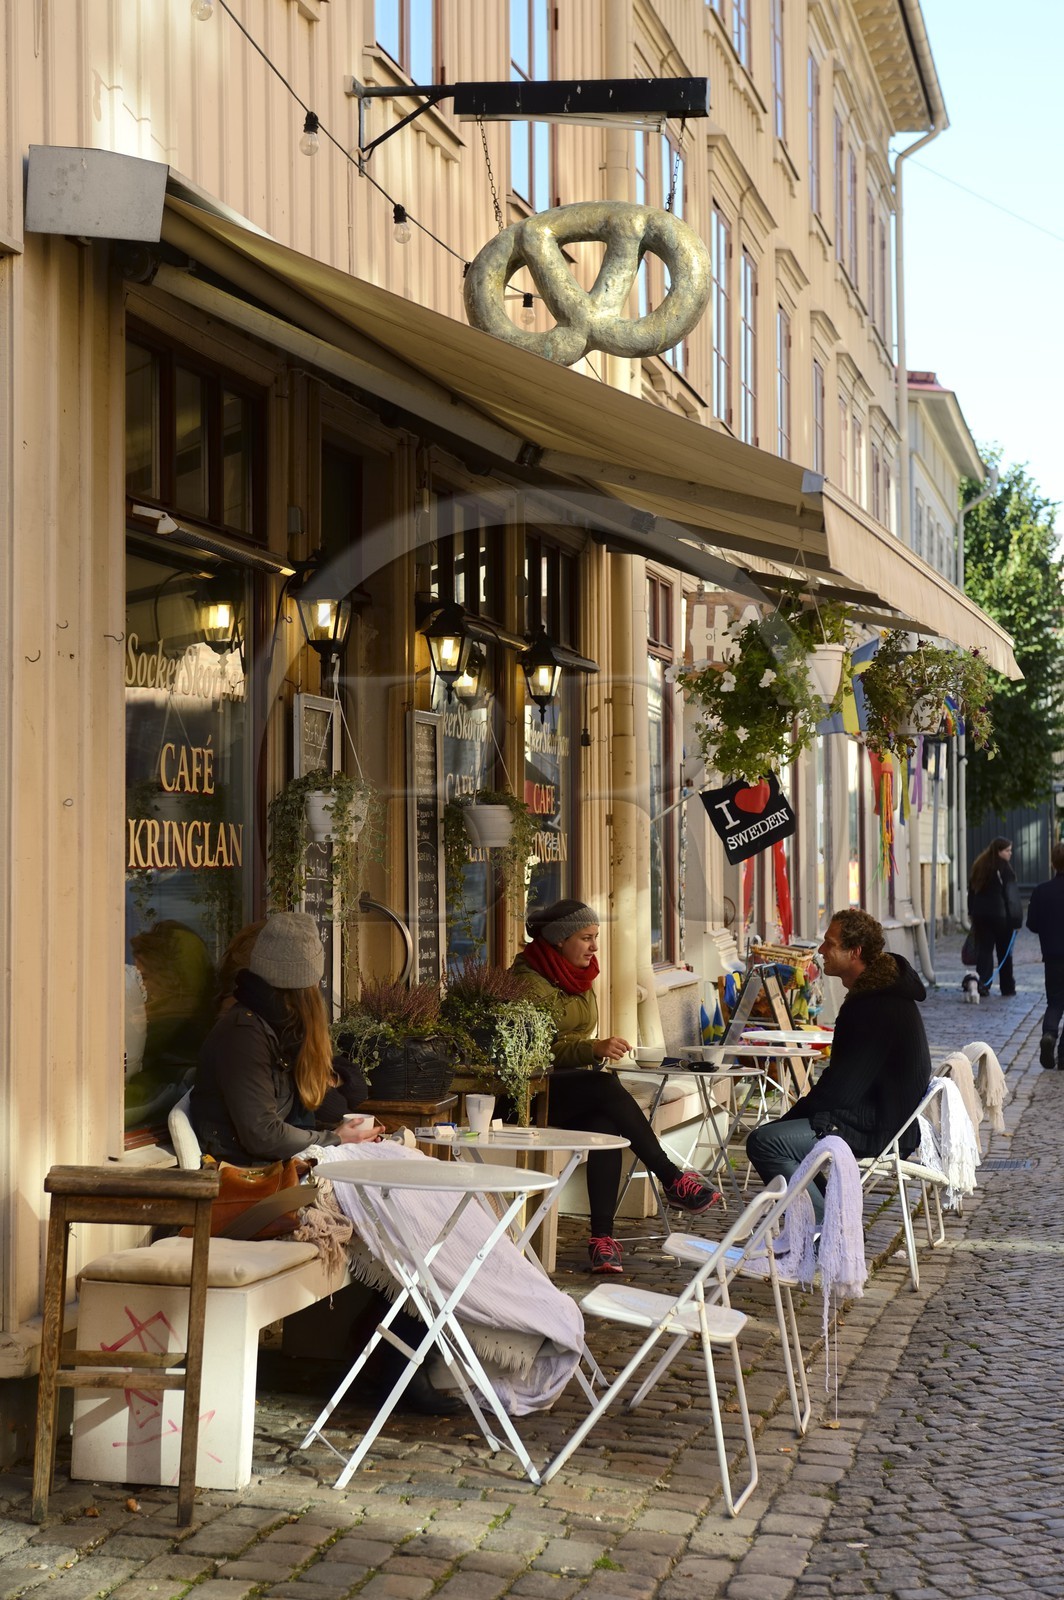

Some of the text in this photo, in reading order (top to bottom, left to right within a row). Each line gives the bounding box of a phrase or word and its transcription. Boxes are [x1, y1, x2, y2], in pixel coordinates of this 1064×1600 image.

[160, 735, 215, 795] CAFÉ
[714, 800, 741, 830] I
[726, 807, 790, 851] SWEDEN
[127, 818, 244, 869] KRINGLAN
